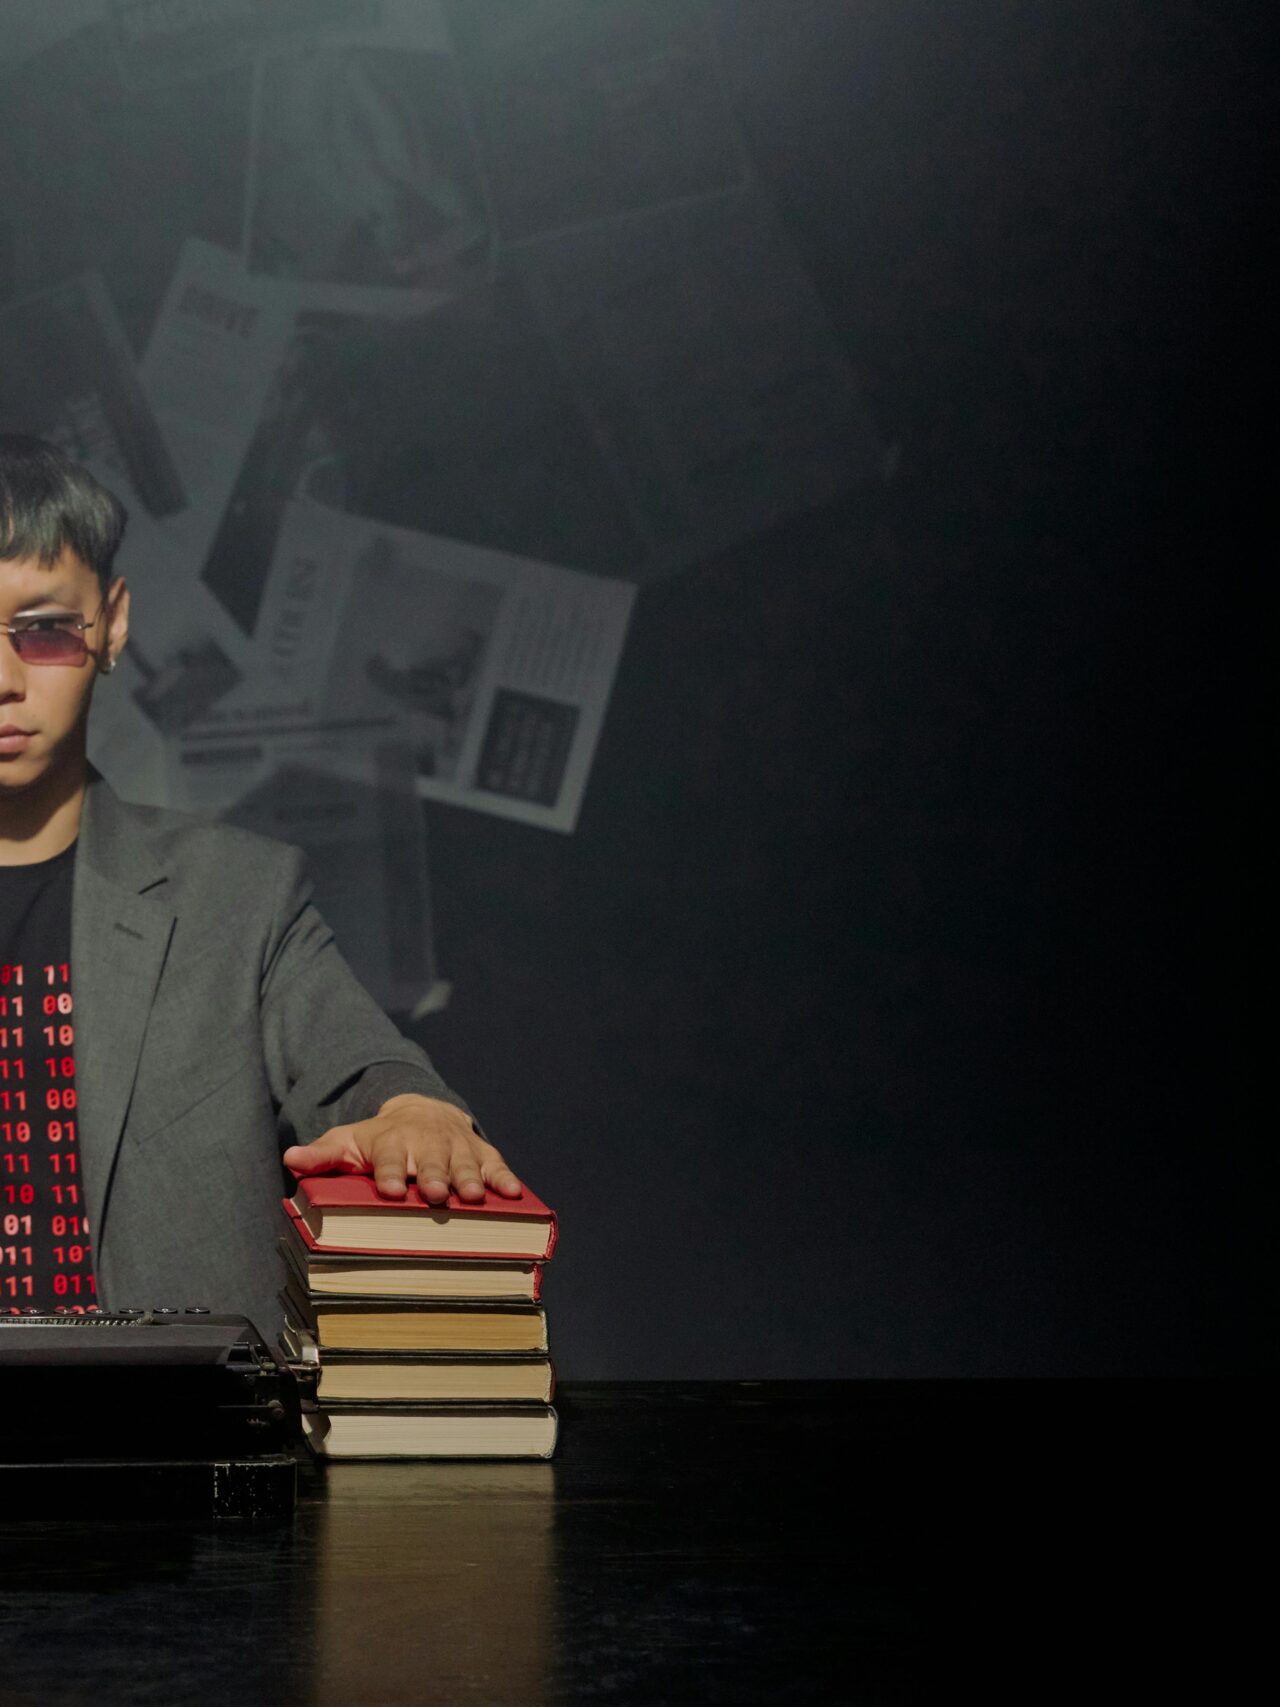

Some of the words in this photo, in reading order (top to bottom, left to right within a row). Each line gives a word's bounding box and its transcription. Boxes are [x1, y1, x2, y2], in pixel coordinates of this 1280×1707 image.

[43, 963, 69, 986] 11
[42, 992, 73, 1016] 00
[43, 1024, 75, 1047] 10
[45, 1056, 76, 1079] 10
[45, 1088, 78, 1111] 00
[47, 1119, 77, 1143] 01
[49, 1152, 78, 1174] 11
[51, 1184, 80, 1205] 11
